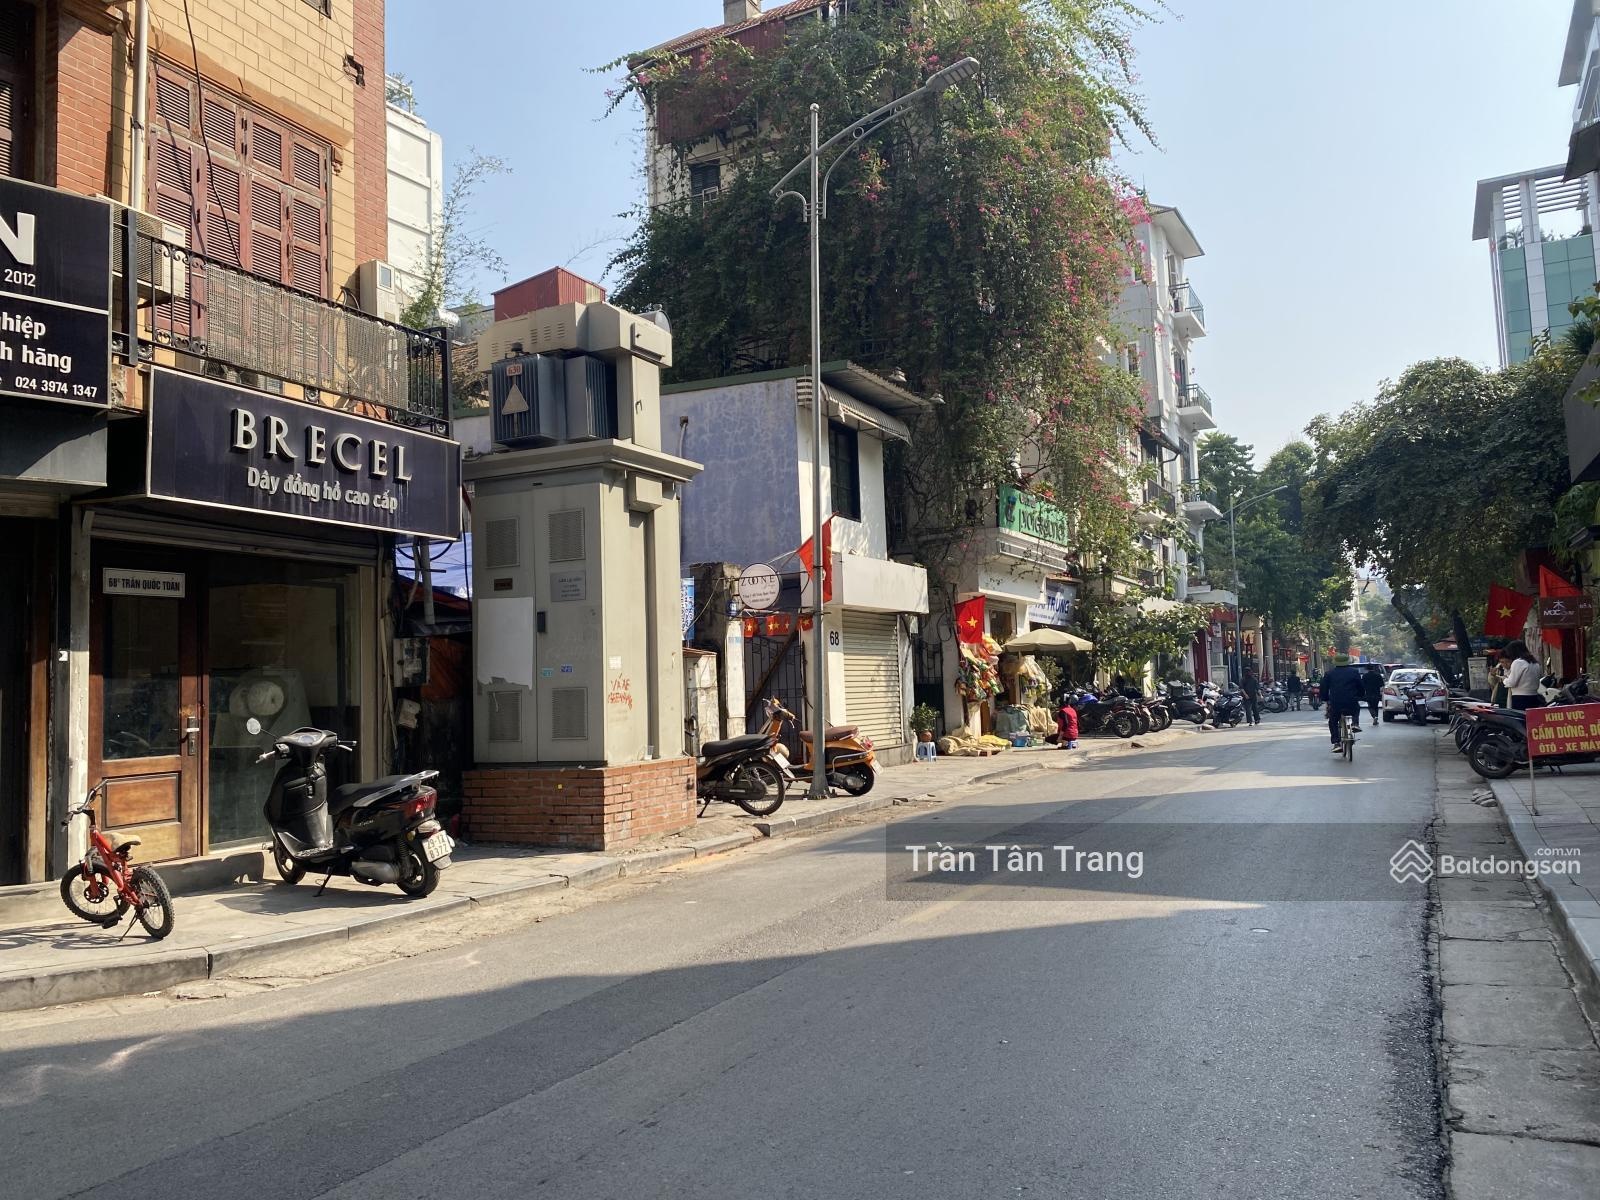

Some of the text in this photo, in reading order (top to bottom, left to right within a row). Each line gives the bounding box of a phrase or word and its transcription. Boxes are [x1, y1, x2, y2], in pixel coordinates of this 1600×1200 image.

[4, 268, 36, 287] 2012
[0, 312, 46, 340] hiệp
[15, 376, 98, 398] 024 3974 1347
[232, 408, 412, 481] BRECEL
[247, 466, 280, 495] Dây
[345, 489, 370, 506] cao
[373, 489, 399, 514] cấp
[1047, 595, 1070, 614] TRUNG
[830, 631, 839, 645] 68
[1545, 711, 1585, 722] KHU VỰC
[1531, 723, 1555, 740] CẤM
[1556, 723, 1588, 739] DỪNG,
[1539, 742, 1557, 752] ÔTÔ
[1565, 742, 1578, 752] XE
